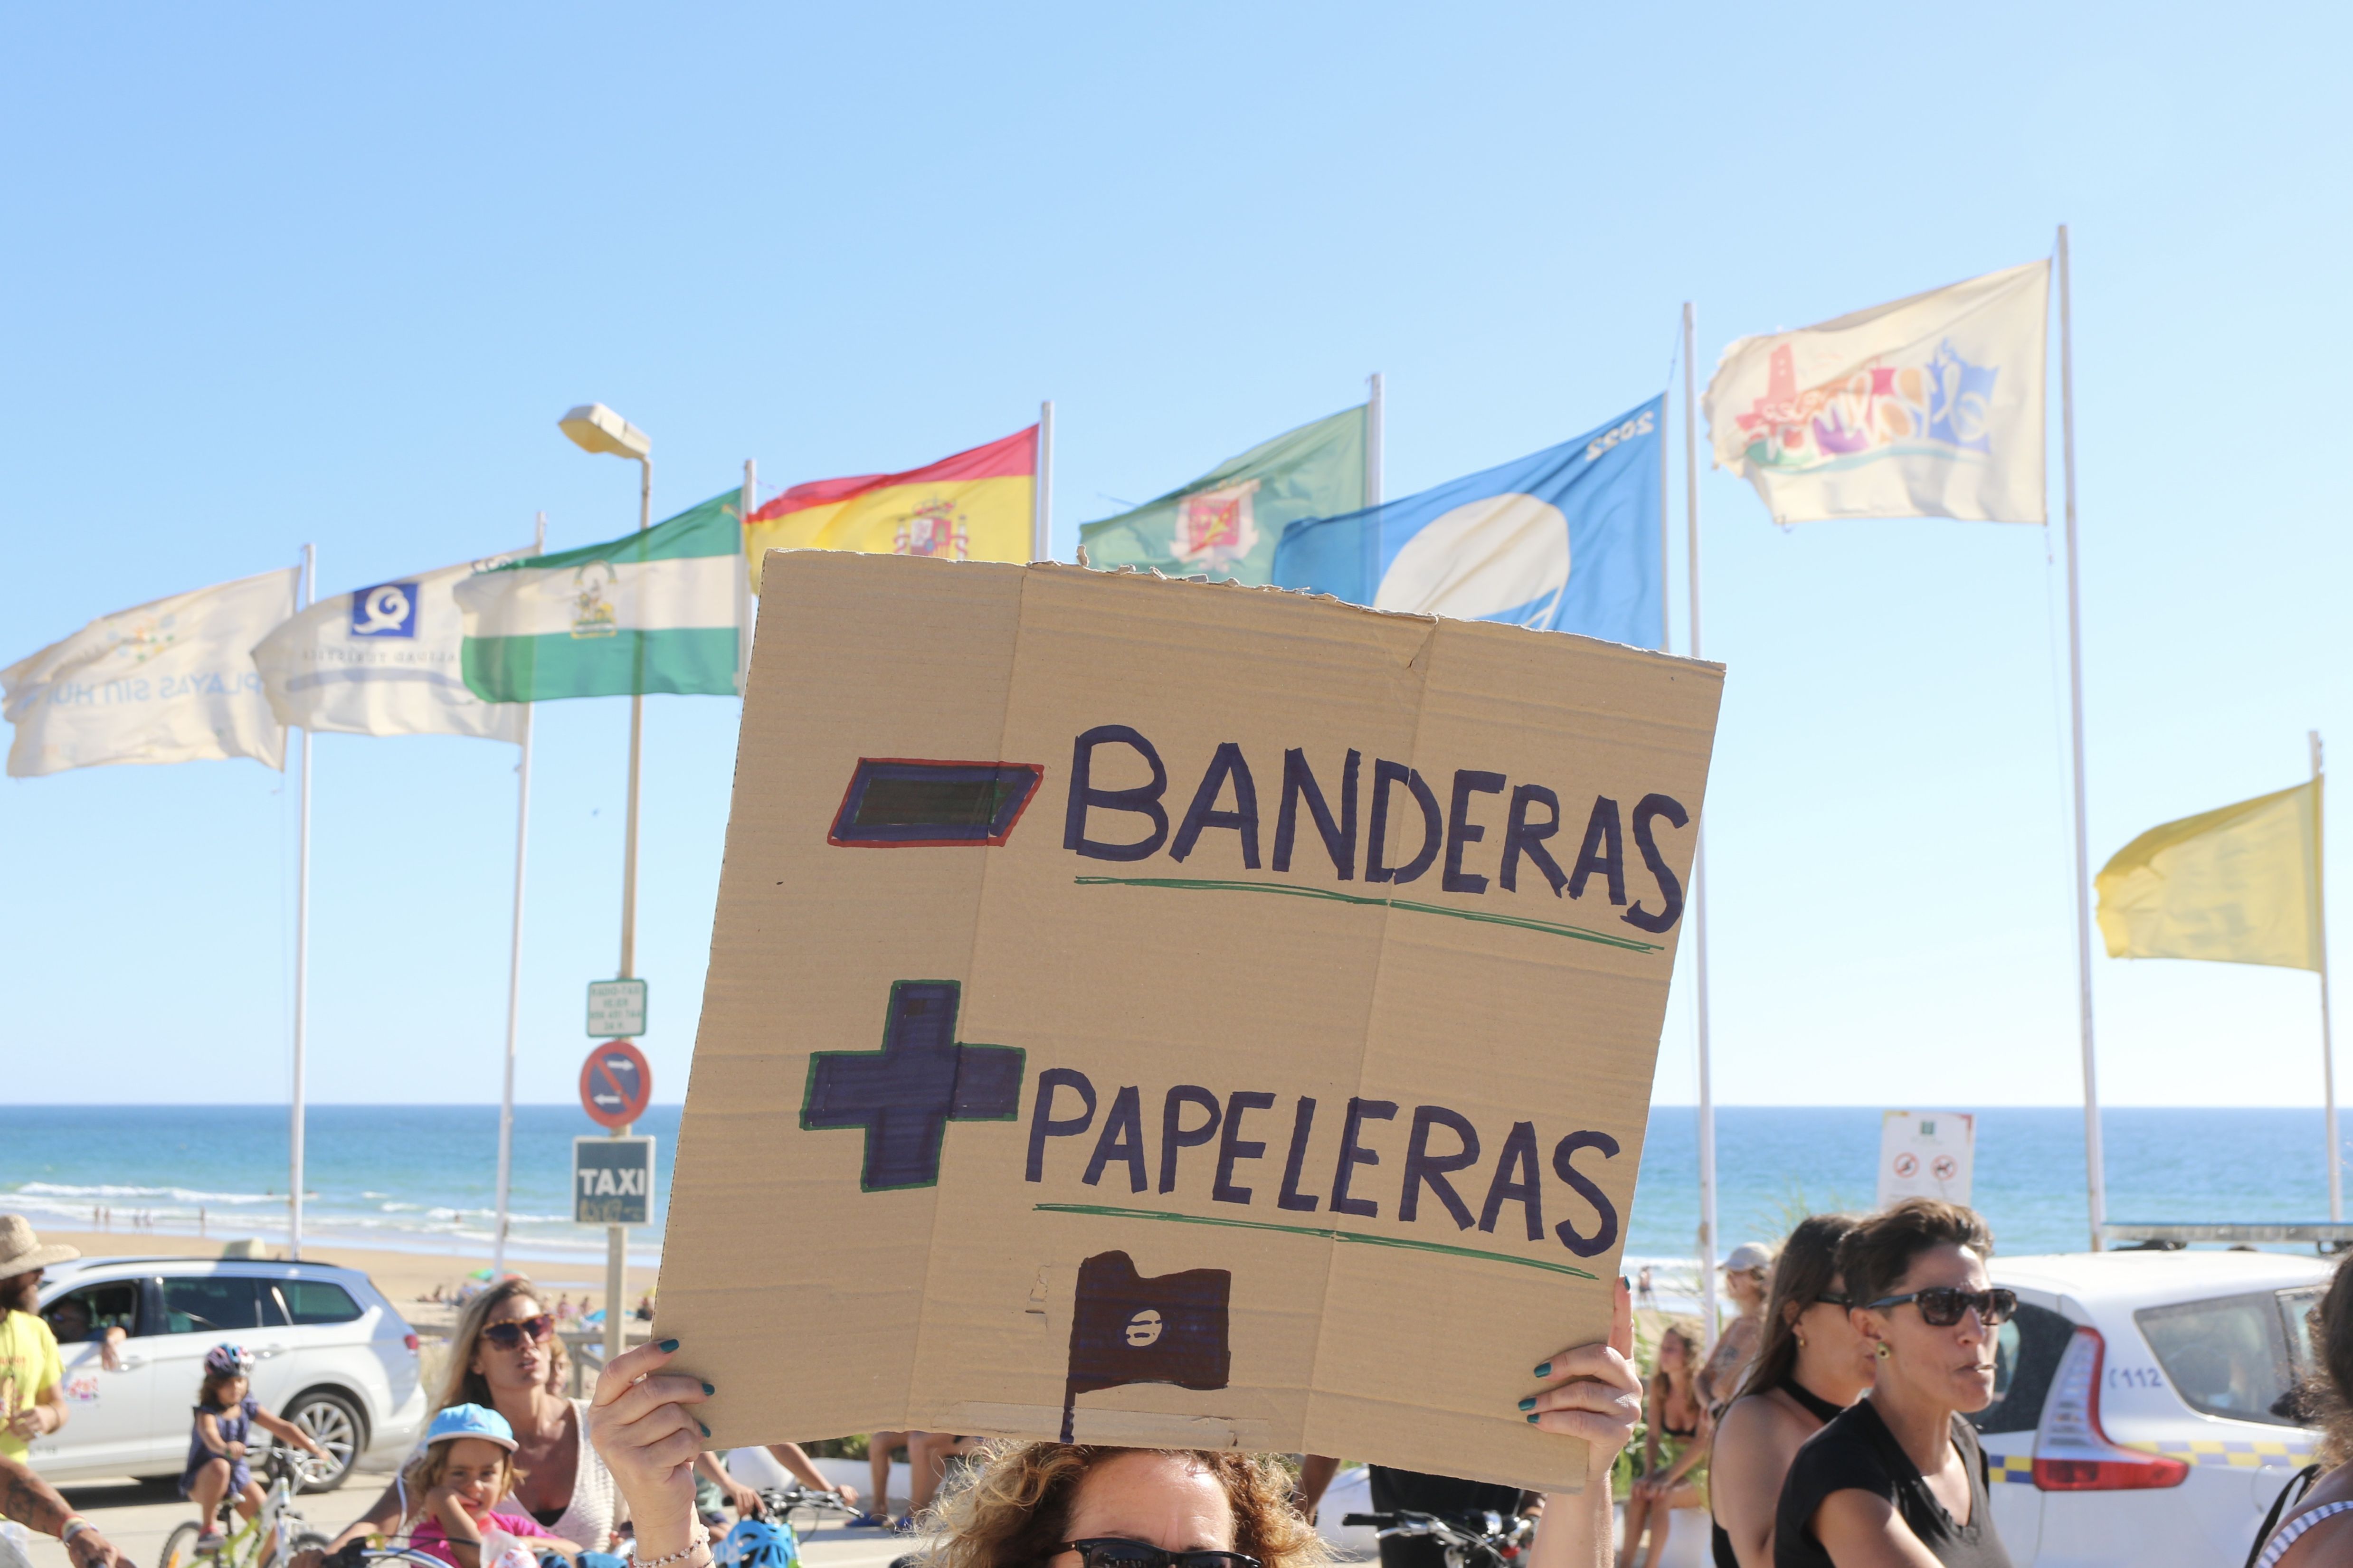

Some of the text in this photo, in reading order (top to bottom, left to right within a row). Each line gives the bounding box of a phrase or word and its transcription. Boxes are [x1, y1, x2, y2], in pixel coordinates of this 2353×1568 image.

[1064, 724, 1689, 934] BANDERAS
[578, 1168, 645, 1196] TAXI
[1026, 1068, 1620, 1257] PAPELERAS
